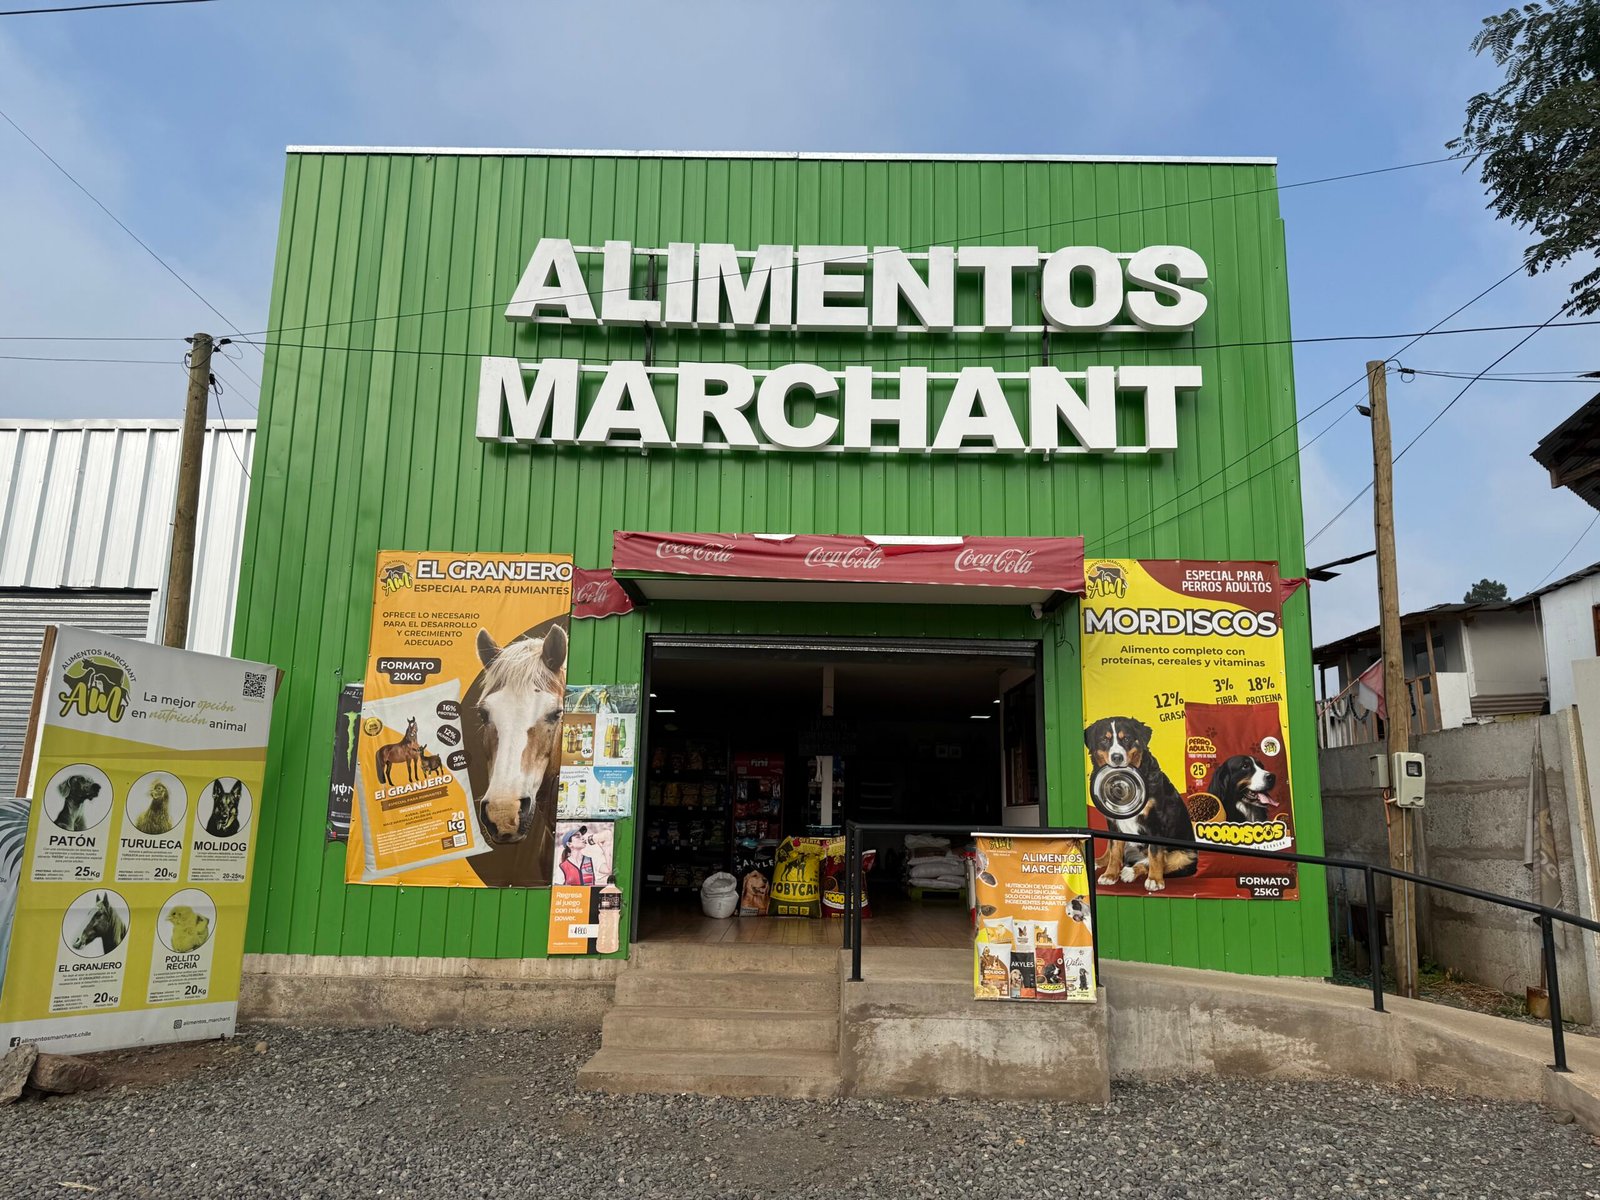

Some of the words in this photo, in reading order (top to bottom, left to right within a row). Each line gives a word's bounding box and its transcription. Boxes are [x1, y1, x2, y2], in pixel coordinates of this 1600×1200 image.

[504, 237, 1208, 332] ALIMENTOS
[475, 356, 1202, 453] MARCHANT
[416, 559, 446, 579] EL
[447, 560, 573, 582] GRANJERO
[1186, 570, 1234, 581] ESPECIAL
[1236, 571, 1264, 582] PARA
[414, 585, 467, 594] ESPECIAL
[470, 586, 501, 594] PARA
[505, 586, 570, 596] RUMIANTES
[1182, 581, 1221, 592] PERROS
[1225, 581, 1273, 593] ADULTOS
[382, 611, 416, 619] OFRECE
[431, 612, 480, 620] NECESARIO
[383, 620, 406, 628] PARA
[421, 621, 478, 629] DESARROLLO
[1083, 607, 1280, 637] MORDISCOS
[396, 629, 402, 637] Y
[404, 629, 463, 638] CRECIMIENTO
[404, 639, 453, 647] ADECUADO
[1120, 645, 1169, 654] Alimento
[1173, 646, 1223, 657] completo
[61, 648, 102, 671] ALIMENTOS
[103, 650, 137, 682] MARCHANT
[380, 661, 435, 670] FORMATO
[1101, 655, 1155, 666] proteínas,
[1157, 657, 1202, 666] cereales
[1204, 660, 1211, 668] y
[1213, 658, 1266, 667] vitaminas
[393, 672, 422, 681] 20KG
[1213, 677, 1234, 693] 3%
[1247, 676, 1275, 692] 18%
[143, 691, 158, 703] La
[161, 695, 196, 709] mejor
[197, 700, 237, 714] opción
[1153, 691, 1184, 709] 12%
[1215, 694, 1239, 705] FIBRA
[1246, 693, 1283, 705] PROTEINA
[442, 704, 457, 712] 16%
[131, 709, 147, 719] en
[149, 707, 208, 725] nutrición
[209, 720, 247, 732] animal
[1159, 710, 1187, 722] GRASA
[443, 727, 457, 740] 12%
[1188, 738, 1210, 746] PERRO
[452, 754, 465, 763] 9%
[1192, 764, 1204, 776] 25
[387, 774, 454, 797] GRANJERO
[450, 810, 466, 821] 20
[447, 819, 466, 833] kg
[1196, 822, 1285, 845] MORDISCOS
[49, 834, 96, 847] PATÓN
[120, 838, 182, 849] TURULECA
[193, 841, 247, 852] MOLIDOG
[1021, 853, 1083, 863] ALIMENTOS
[1021, 864, 1084, 875] MARCHANT
[1239, 877, 1290, 886] FORMATO
[1253, 888, 1280, 897] 25KG
[165, 954, 200, 963] POLLITO
[58, 964, 70, 973] EL
[72, 961, 122, 972] GRANJERO
[166, 962, 197, 970] RECRIA
